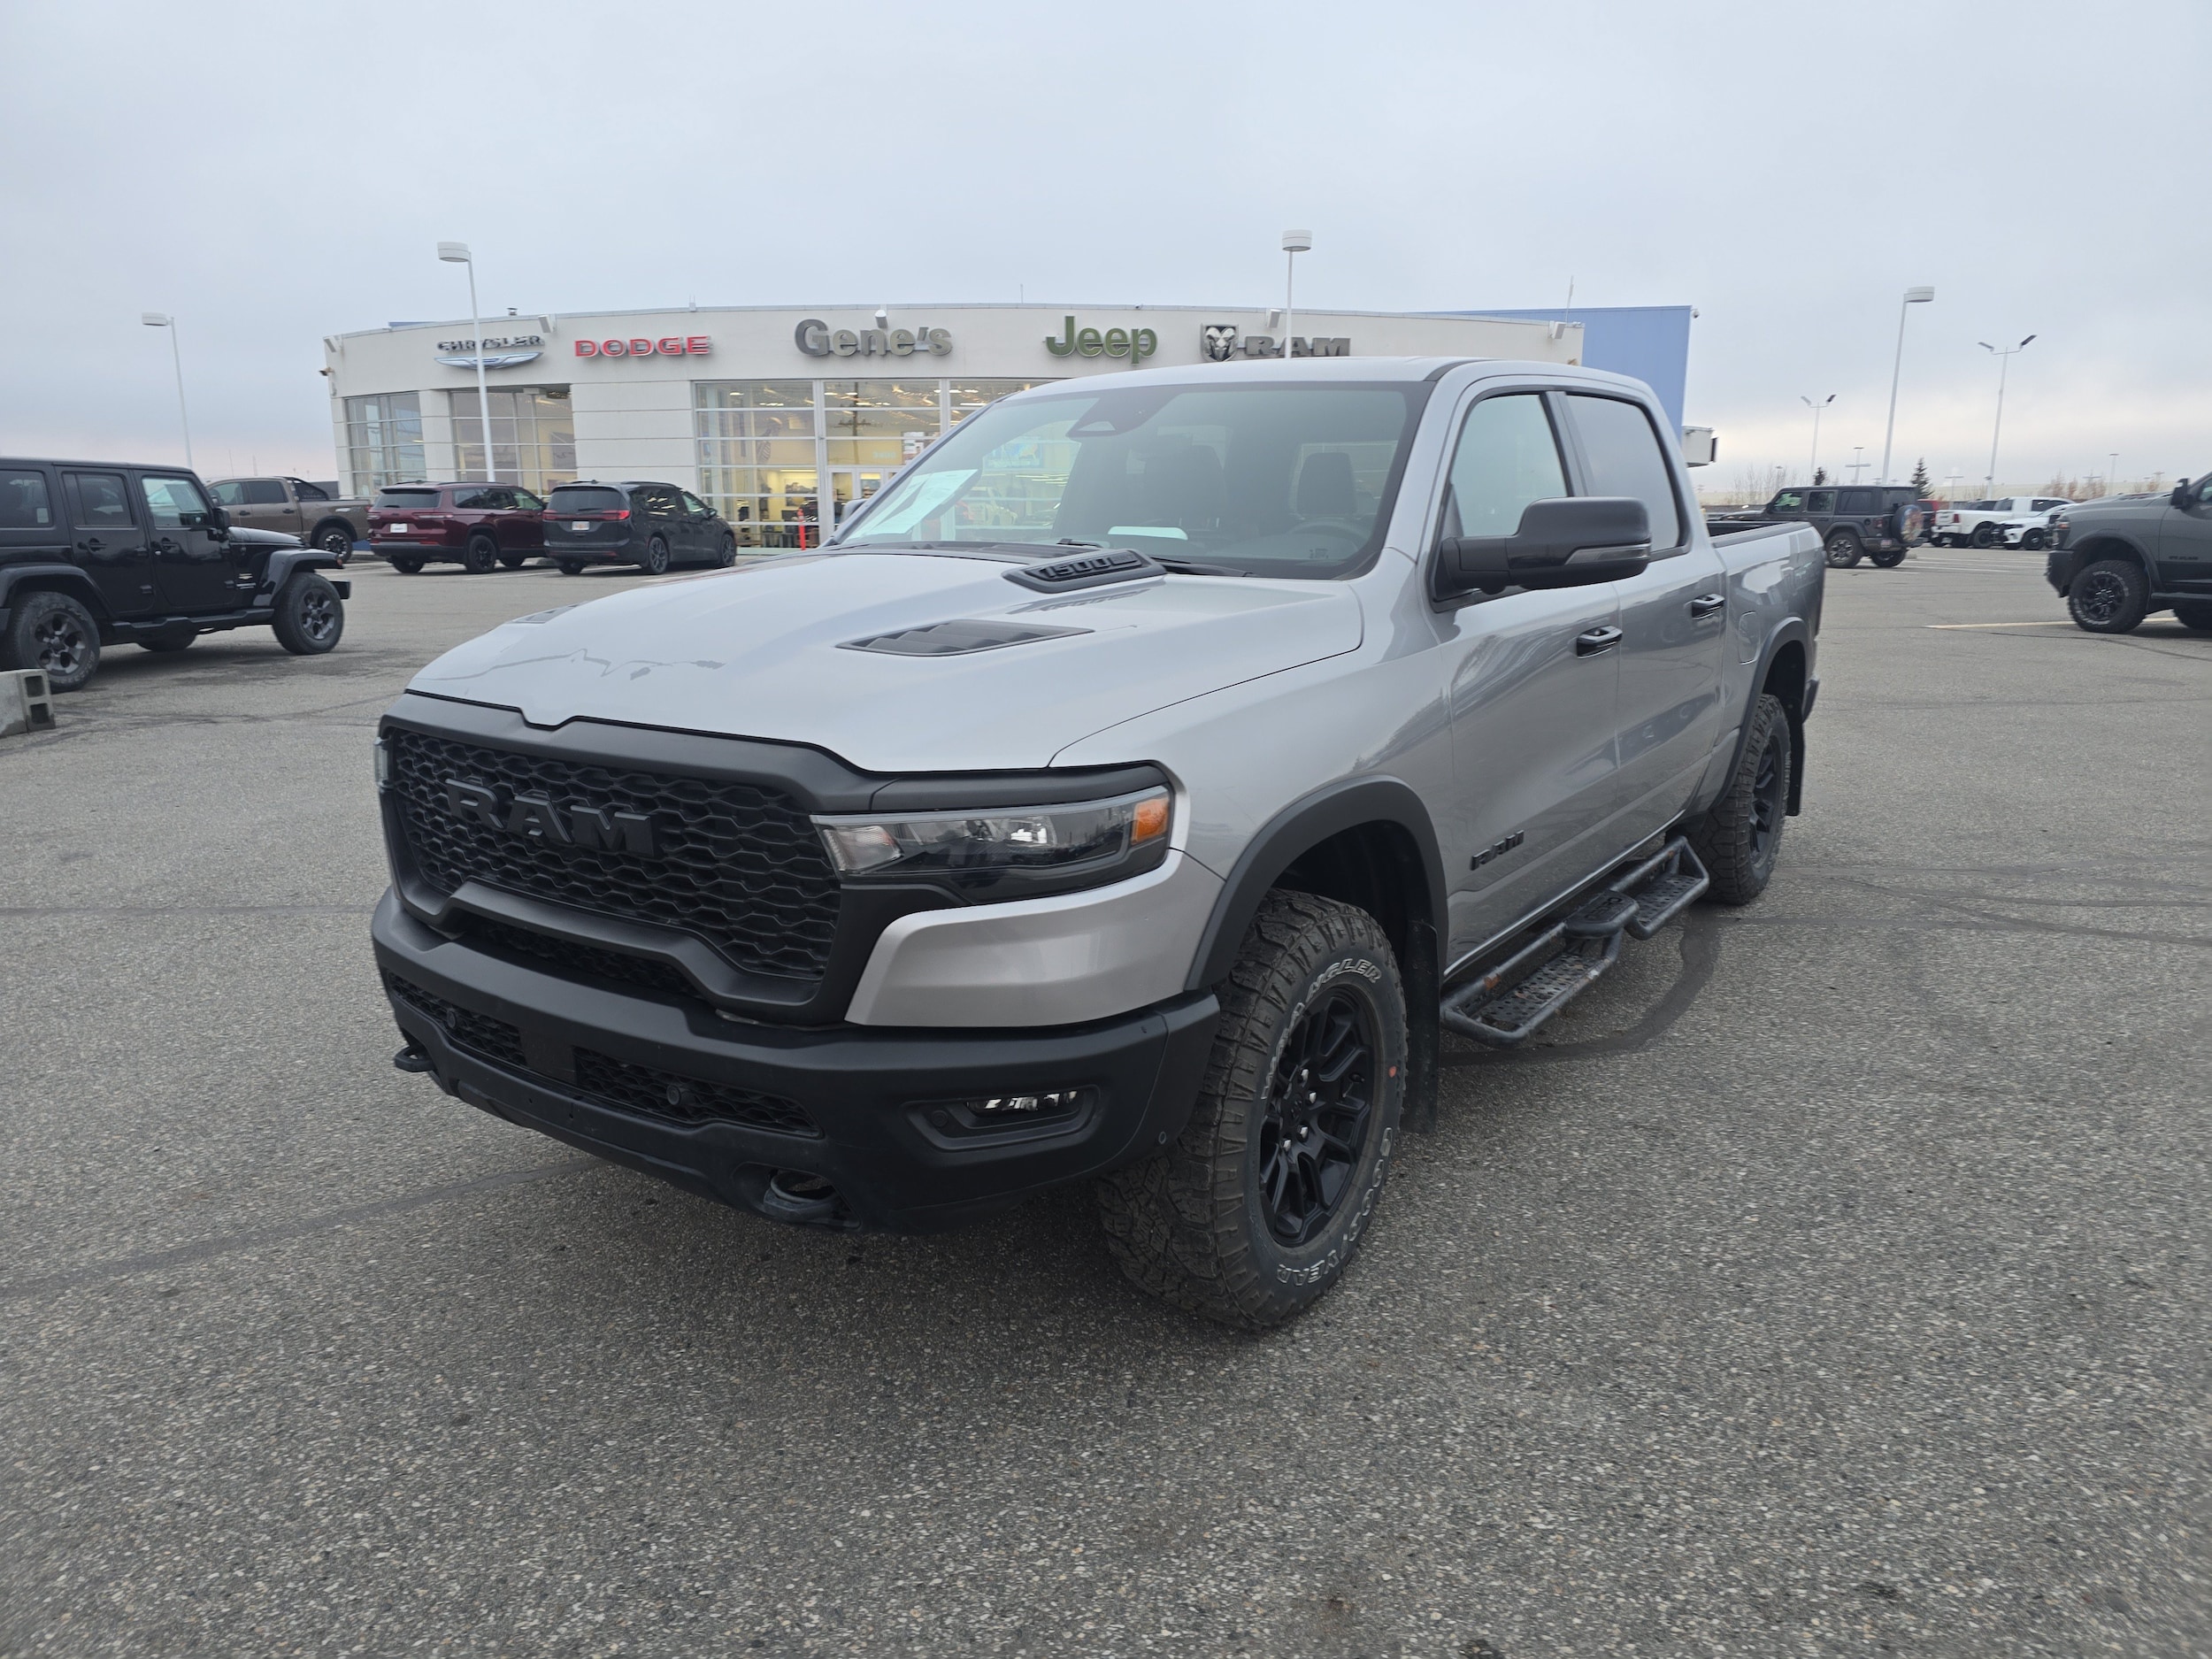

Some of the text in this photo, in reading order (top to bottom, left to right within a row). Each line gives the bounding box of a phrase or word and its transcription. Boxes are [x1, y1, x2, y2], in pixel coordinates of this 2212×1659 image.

[574, 335, 710, 357] DODGE
[795, 319, 953, 357] Gene's
[1046, 316, 1158, 365] Jeep
[1245, 335, 1351, 356] RAM
[1039, 556, 1111, 578] 1500
[445, 778, 655, 857] RAM
